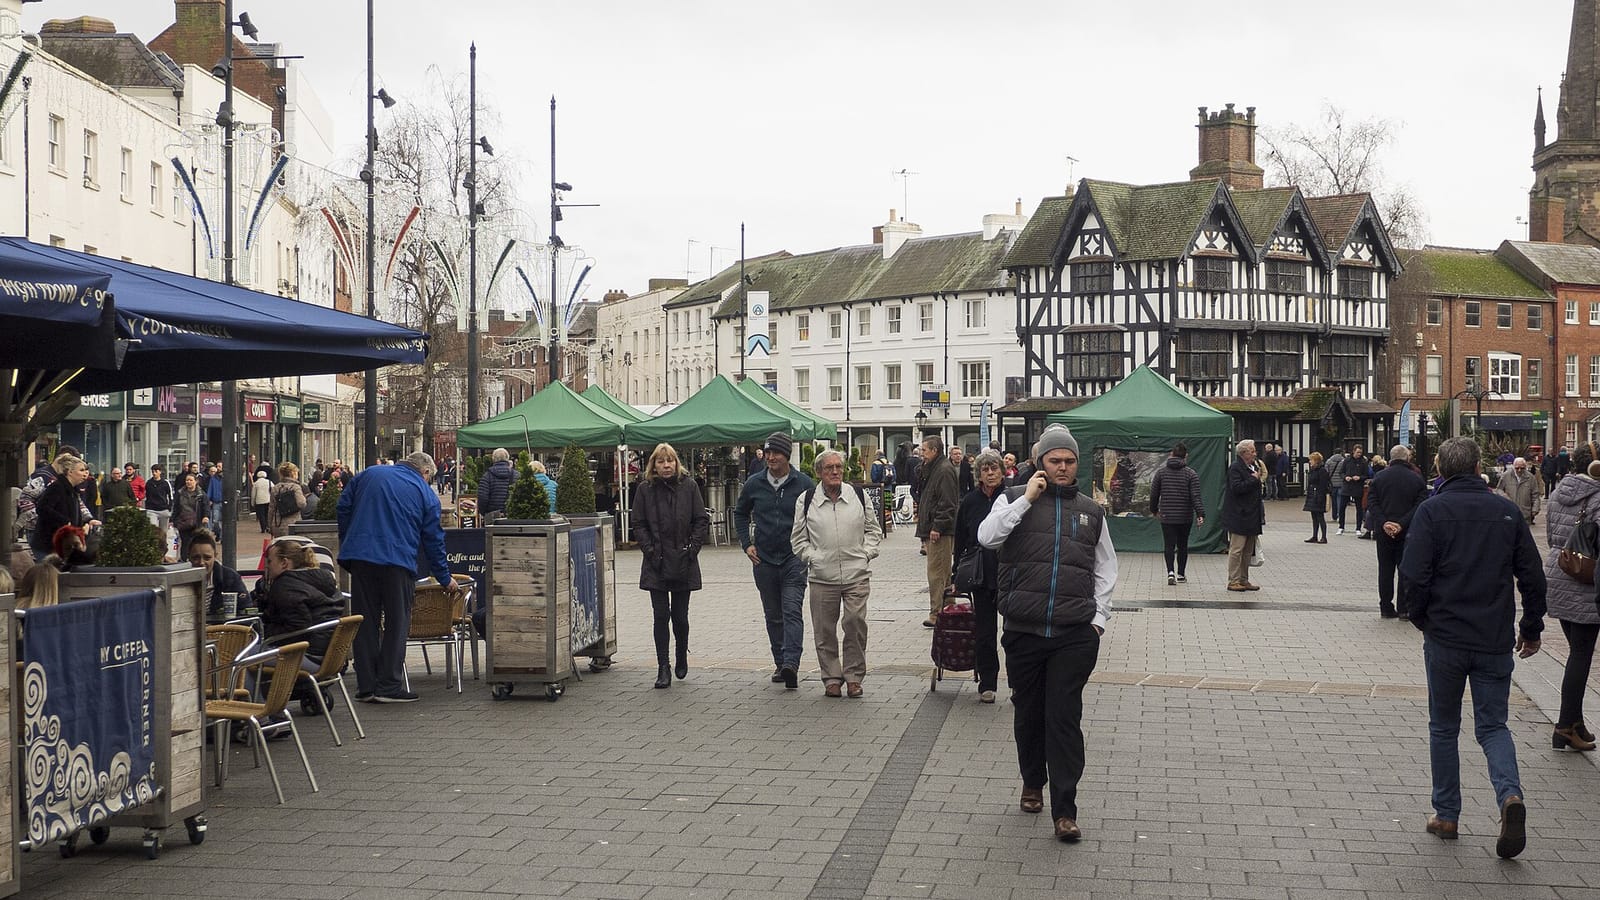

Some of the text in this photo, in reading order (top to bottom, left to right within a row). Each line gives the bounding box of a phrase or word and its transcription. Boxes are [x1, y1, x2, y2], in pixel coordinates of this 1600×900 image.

[157, 386, 177, 413] AME
[1576, 400, 1587, 409] The
[251, 403, 267, 418] COSTA
[446, 553, 484, 564] Coffee and
[468, 563, 481, 572] the
[108, 575, 117, 584] 2
[142, 656, 150, 747] CORNER
